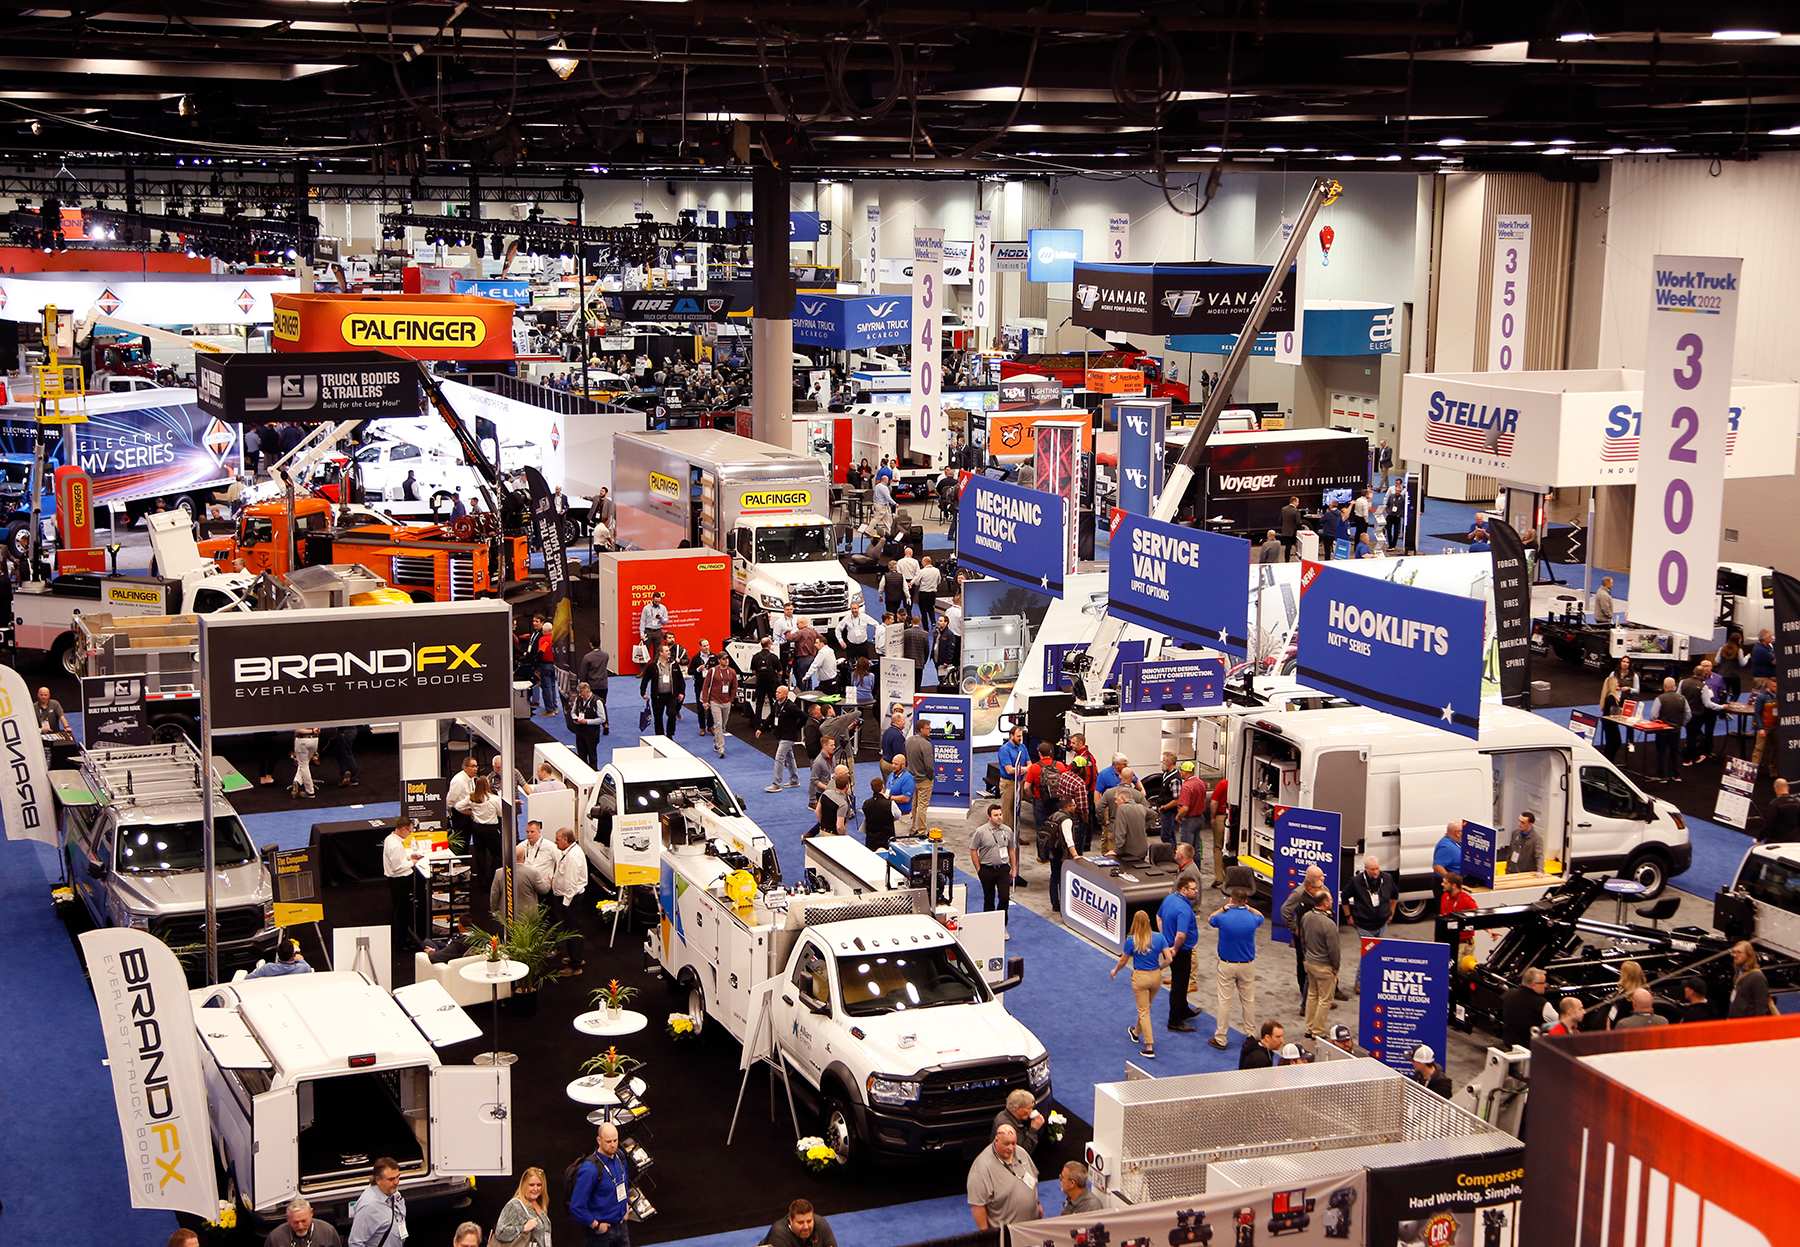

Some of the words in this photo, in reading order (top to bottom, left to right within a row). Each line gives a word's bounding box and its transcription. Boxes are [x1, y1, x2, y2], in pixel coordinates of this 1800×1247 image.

[489, 289, 530, 297] ELMS
[1102, 289, 1146, 305] VANAIR
[1208, 292, 1283, 306] VANAR
[632, 300, 673, 310] ARE
[1500, 248, 1518, 371] 3500
[351, 319, 476, 341] PALFINGER
[818, 321, 835, 332] TRUCK
[857, 322, 885, 333] SMYRNA
[886, 320, 909, 330] TRUCK
[806, 331, 828, 339] CARGO
[872, 331, 900, 339] CARGO
[920, 274, 933, 439] 3400
[321, 373, 357, 386] TRUCK
[361, 371, 400, 384] BODIES
[245, 374, 318, 411] J&J
[332, 385, 383, 399] TRAILERS
[340, 401, 350, 409] for
[351, 400, 363, 408] the
[364, 400, 381, 409] Long
[382, 399, 398, 408] Haul
[1428, 391, 1519, 433] STELLAR
[81, 430, 174, 452] ELECTRIC
[81, 452, 109, 474] MV
[114, 443, 175, 470] SERIES
[1424, 448, 1482, 465] INDUSTRIES
[1488, 460, 1510, 469] INC.
[1658, 333, 1704, 606] 3200
[651, 476, 679, 497] PALFINGER
[1219, 474, 1275, 493] Voyager
[1288, 478, 1313, 487] EXPAND
[1317, 477, 1334, 485] YOUR
[745, 494, 806, 505] PALFINGER
[976, 488, 1042, 526] MECHANIC
[539, 518, 549, 539] THE
[976, 510, 1017, 544] TRUCK
[549, 522, 561, 552] HAUL
[975, 534, 1003, 553] INNOVATIONS
[543, 540, 554, 561] FOR
[1132, 528, 1200, 568] SERVICE
[1132, 552, 1166, 585] VAN
[1498, 558, 1519, 568] FORGED
[1301, 566, 1316, 588] NEW!
[1500, 579, 1507, 588] IN
[1508, 578, 1519, 587] THE
[112, 590, 158, 601] PALFINGER
[642, 591, 666, 599] STAD
[1131, 580, 1146, 593] UPFIT
[1146, 584, 1170, 601] OPTIONS
[1504, 598, 1519, 608] FIRES
[1328, 600, 1449, 656] HOOKLIFTS
[1503, 619, 1510, 628] OF
[1511, 618, 1521, 627] THE
[1349, 639, 1372, 657] SERIES
[1500, 638, 1528, 649] AMERICAN
[1506, 658, 1525, 668] SPIRIT
[1166, 671, 1214, 679] CONSTRUCTION.
[89, 680, 140, 707] J&J
[236, 682, 337, 698] EVERLAST
[346, 677, 409, 691] TRUCK
[417, 673, 484, 687] BODIES
[408, 783, 427, 794] Ready
[416, 794, 424, 802] the
[1290, 837, 1324, 851] UPFIT
[1475, 842, 1490, 852] DUTY
[277, 858, 286, 866] The
[1280, 846, 1333, 863] OPTIONS
[1071, 878, 1118, 920] STELLAR
[1383, 969, 1432, 984] NEXT-
[1382, 982, 1427, 997] LEVEL
[1378, 993, 1407, 1002] HOOKLIFT
[1408, 994, 1430, 1004] DESIGN
[104, 955, 131, 1048] EVERLAST
[126, 1058, 144, 1119] TRUCK
[137, 1128, 154, 1195] BODIES
[1409, 1195, 1435, 1209] Hard
[1436, 1191, 1482, 1203] Working,
[1485, 1184, 1522, 1199] Simple,
[1431, 1221, 1449, 1242] CAS
